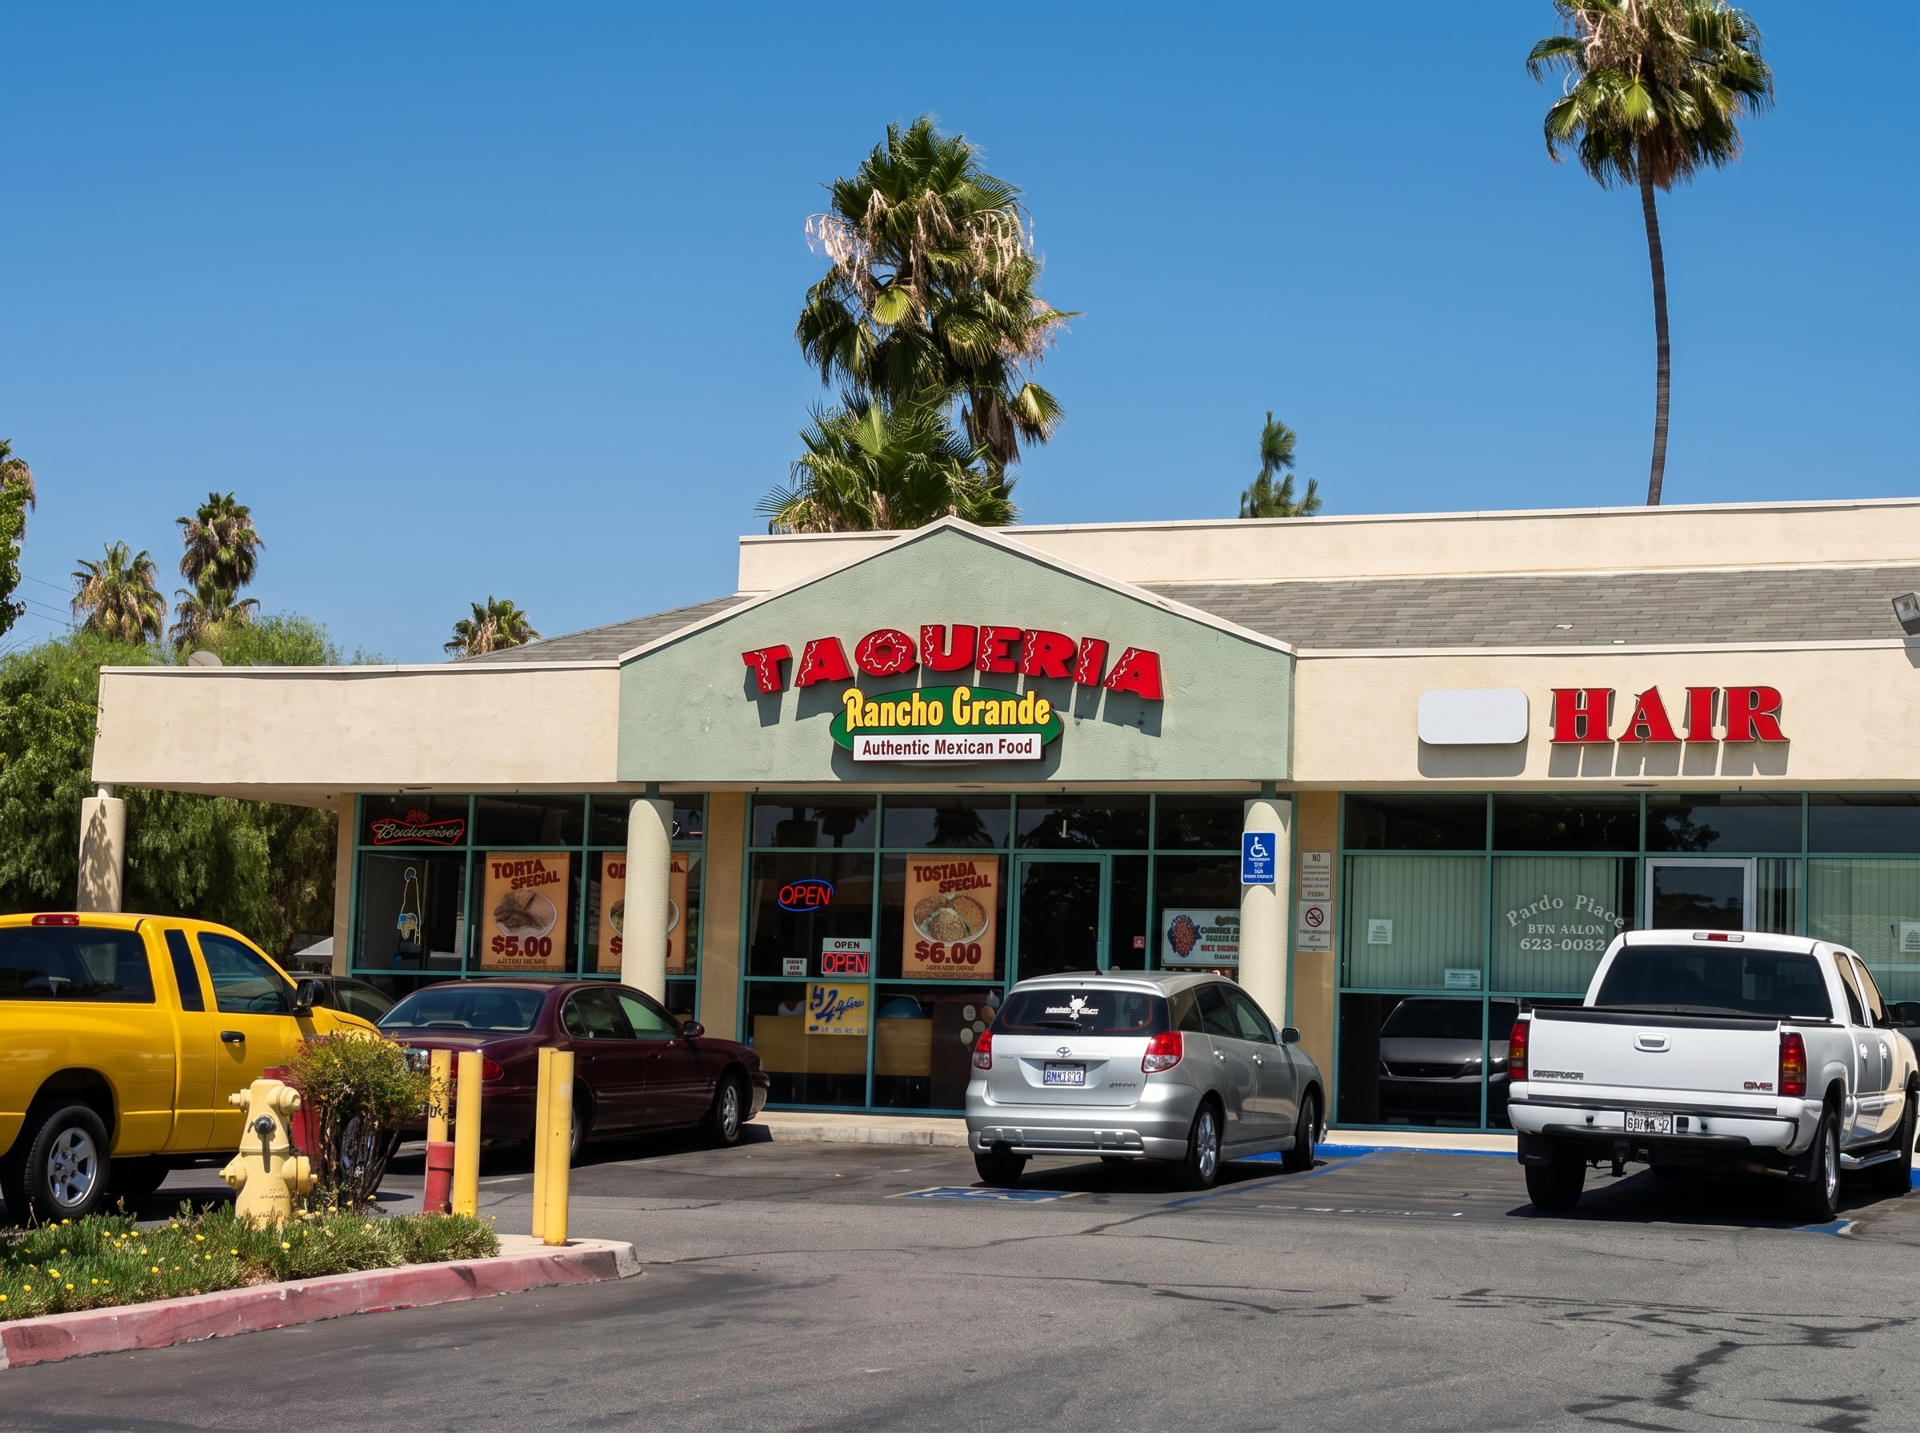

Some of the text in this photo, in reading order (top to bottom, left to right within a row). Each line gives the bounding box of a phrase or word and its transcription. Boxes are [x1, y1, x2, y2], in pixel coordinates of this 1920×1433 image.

[742, 624, 1164, 700] TAQUERIA
[842, 686, 1051, 733] Rancho Grande
[1549, 685, 1790, 743] HAIR
[862, 738, 1033, 756] Authentic Mexican Food
[373, 822, 461, 839] Budweiser
[1312, 854, 1321, 862] NO
[491, 859, 545, 879] TORTA
[913, 862, 977, 882] TOSTADA
[511, 871, 560, 890] SPECIAL
[939, 874, 992, 894] SPECIAL
[778, 885, 831, 906] OPEN
[1506, 894, 1564, 928] Pardo
[491, 935, 553, 958] $5.00
[834, 941, 861, 949] OPEN
[914, 940, 982, 965] $6.00
[823, 953, 867, 973] OPEN
